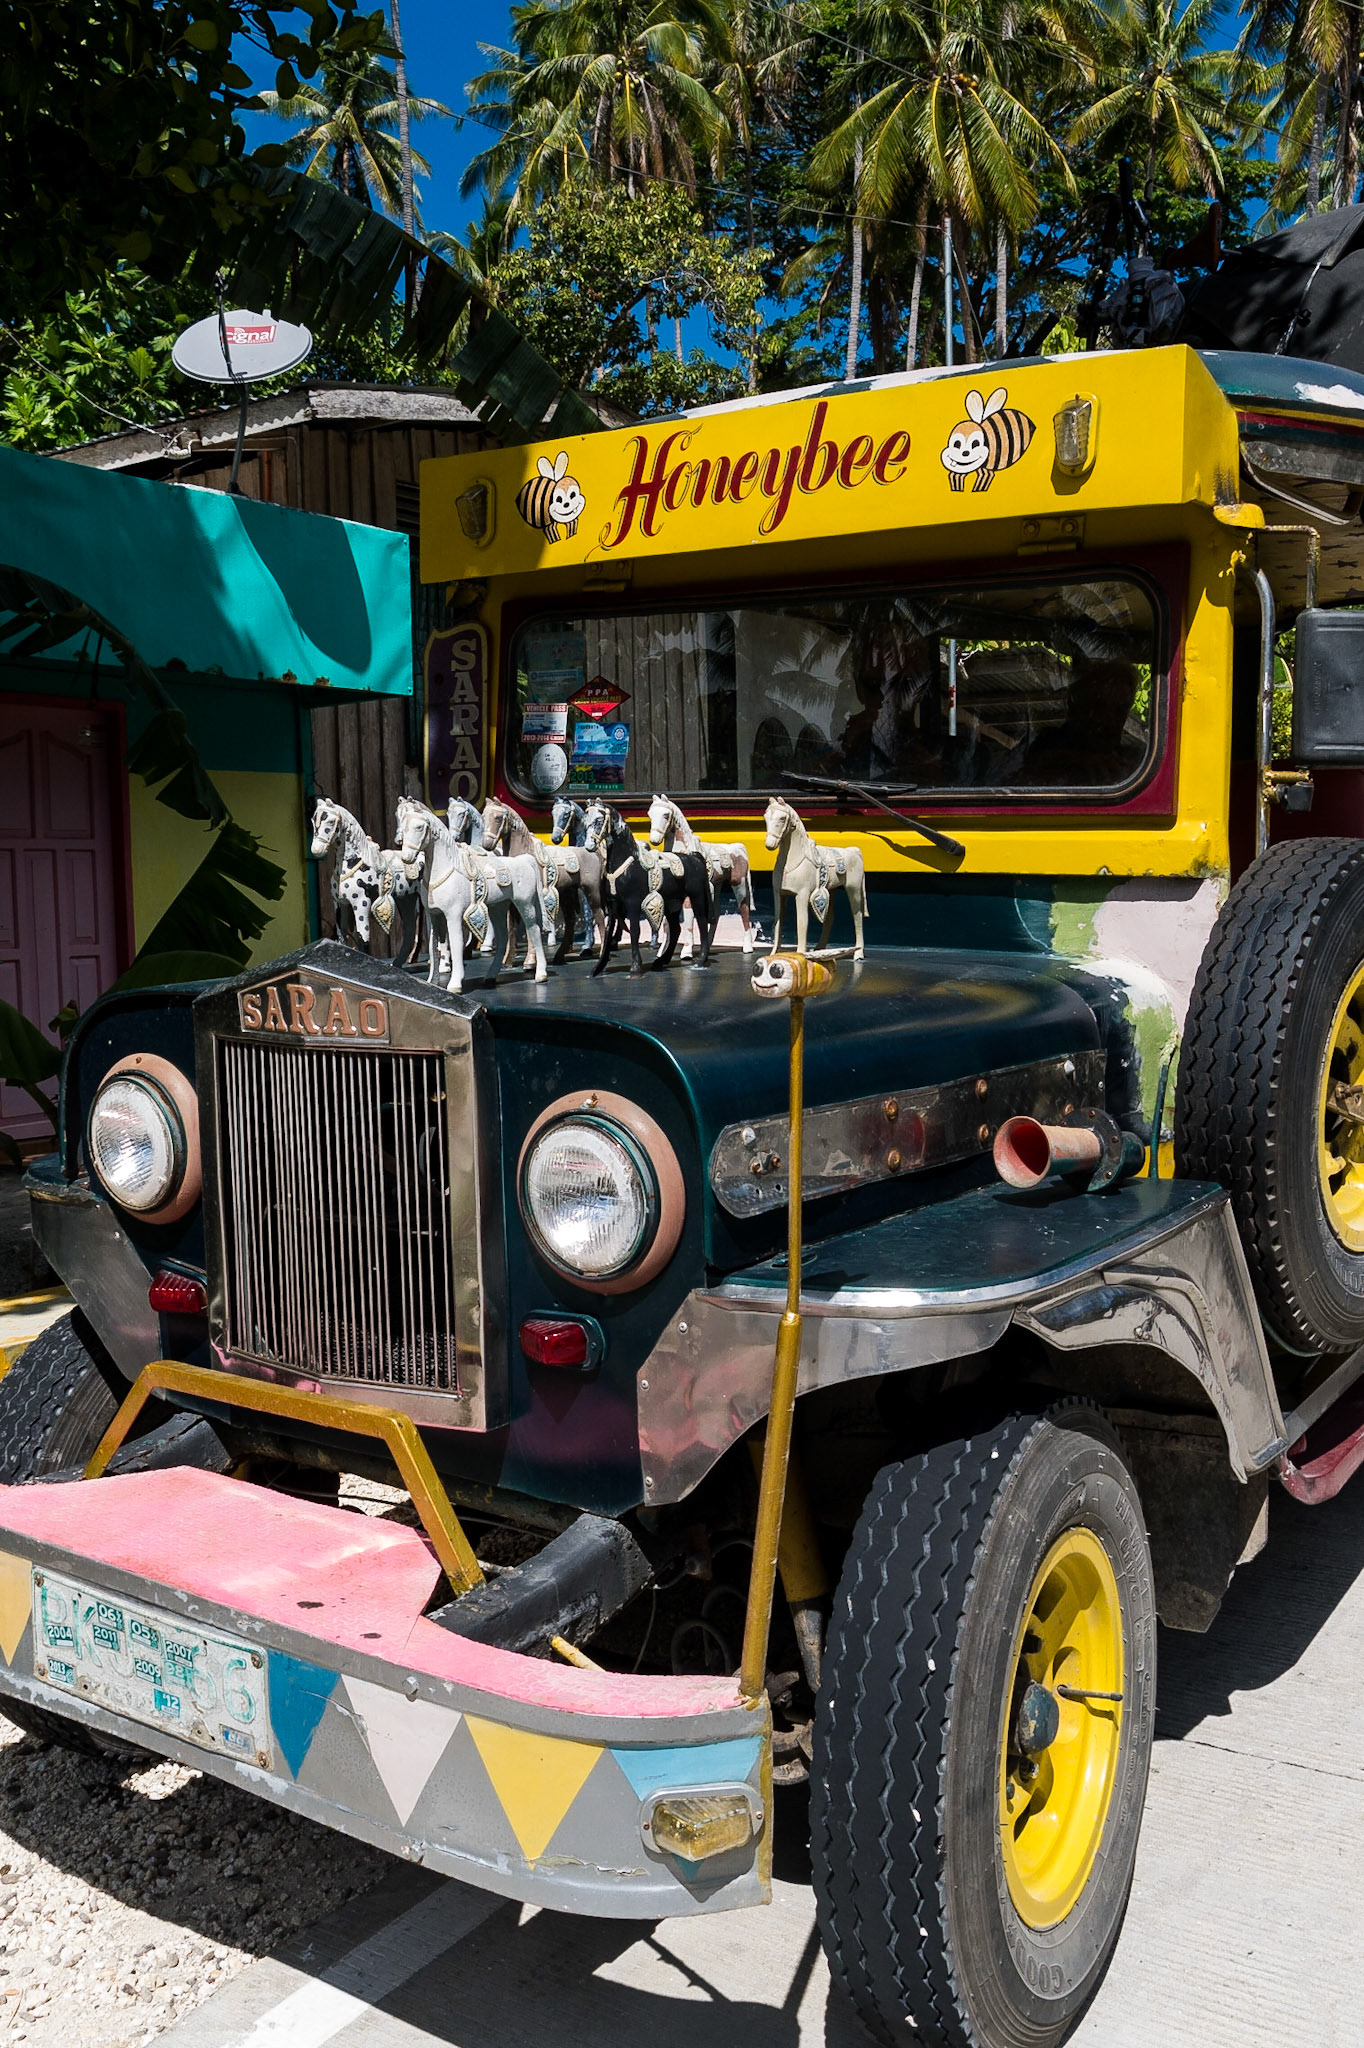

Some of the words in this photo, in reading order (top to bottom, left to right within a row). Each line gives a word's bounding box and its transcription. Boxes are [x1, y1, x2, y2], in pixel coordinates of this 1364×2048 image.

[586, 402, 911, 560] Honeybee
[449, 638, 481, 802] SARAO
[570, 771, 595, 782] 2013
[242, 983, 387, 1037] SARAO
[98, 1604, 117, 1622] 06
[47, 1625, 73, 1640] 2004
[93, 1625, 118, 1643] 2011
[131, 1621, 150, 1640] 05
[166, 1642, 193, 1663] 2007
[49, 1659, 66, 1676] 2013
[135, 1660, 162, 1679] 2009
